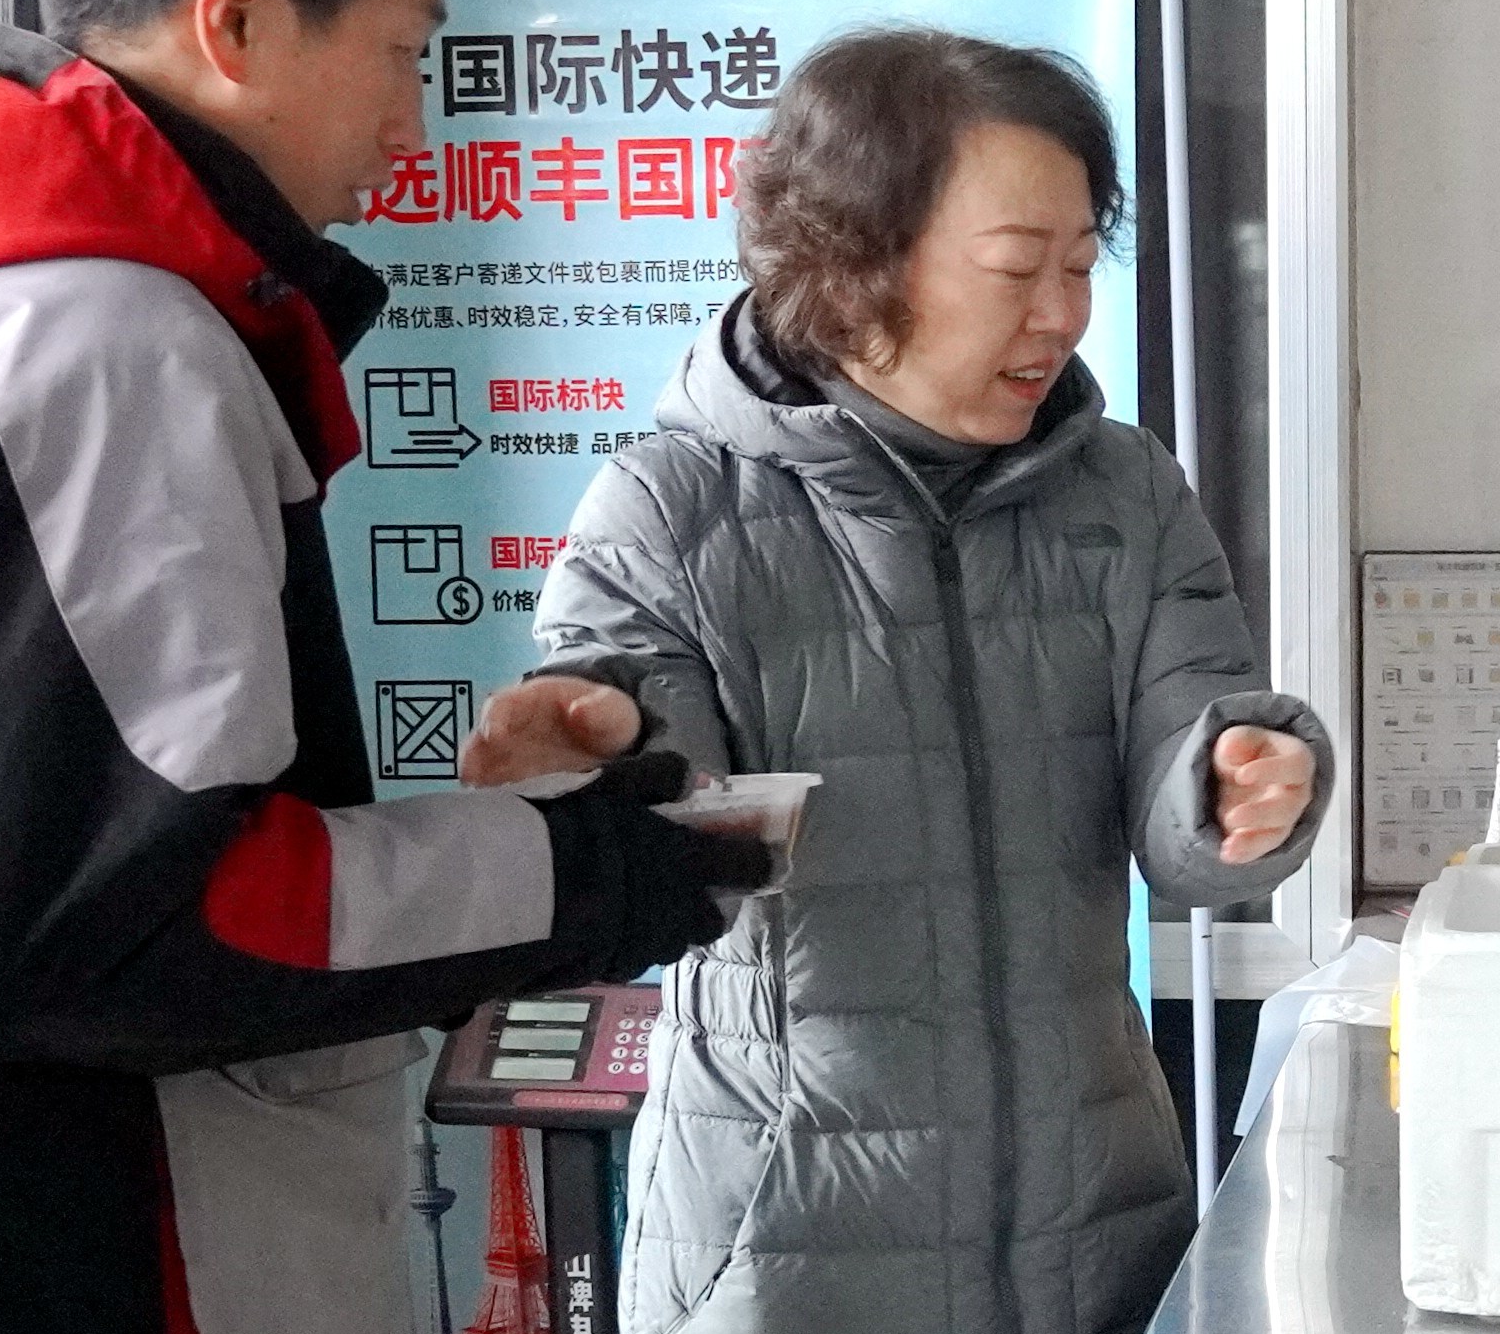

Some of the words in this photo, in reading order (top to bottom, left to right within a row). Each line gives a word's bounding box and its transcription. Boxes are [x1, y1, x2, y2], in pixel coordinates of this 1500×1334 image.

[420, 25, 782, 117] 国际快递
[489, 376, 625, 412] 国际标快
[490, 432, 579, 456] 时效快捷
[490, 535, 570, 570] 国际
[492, 587, 541, 614] 价格
